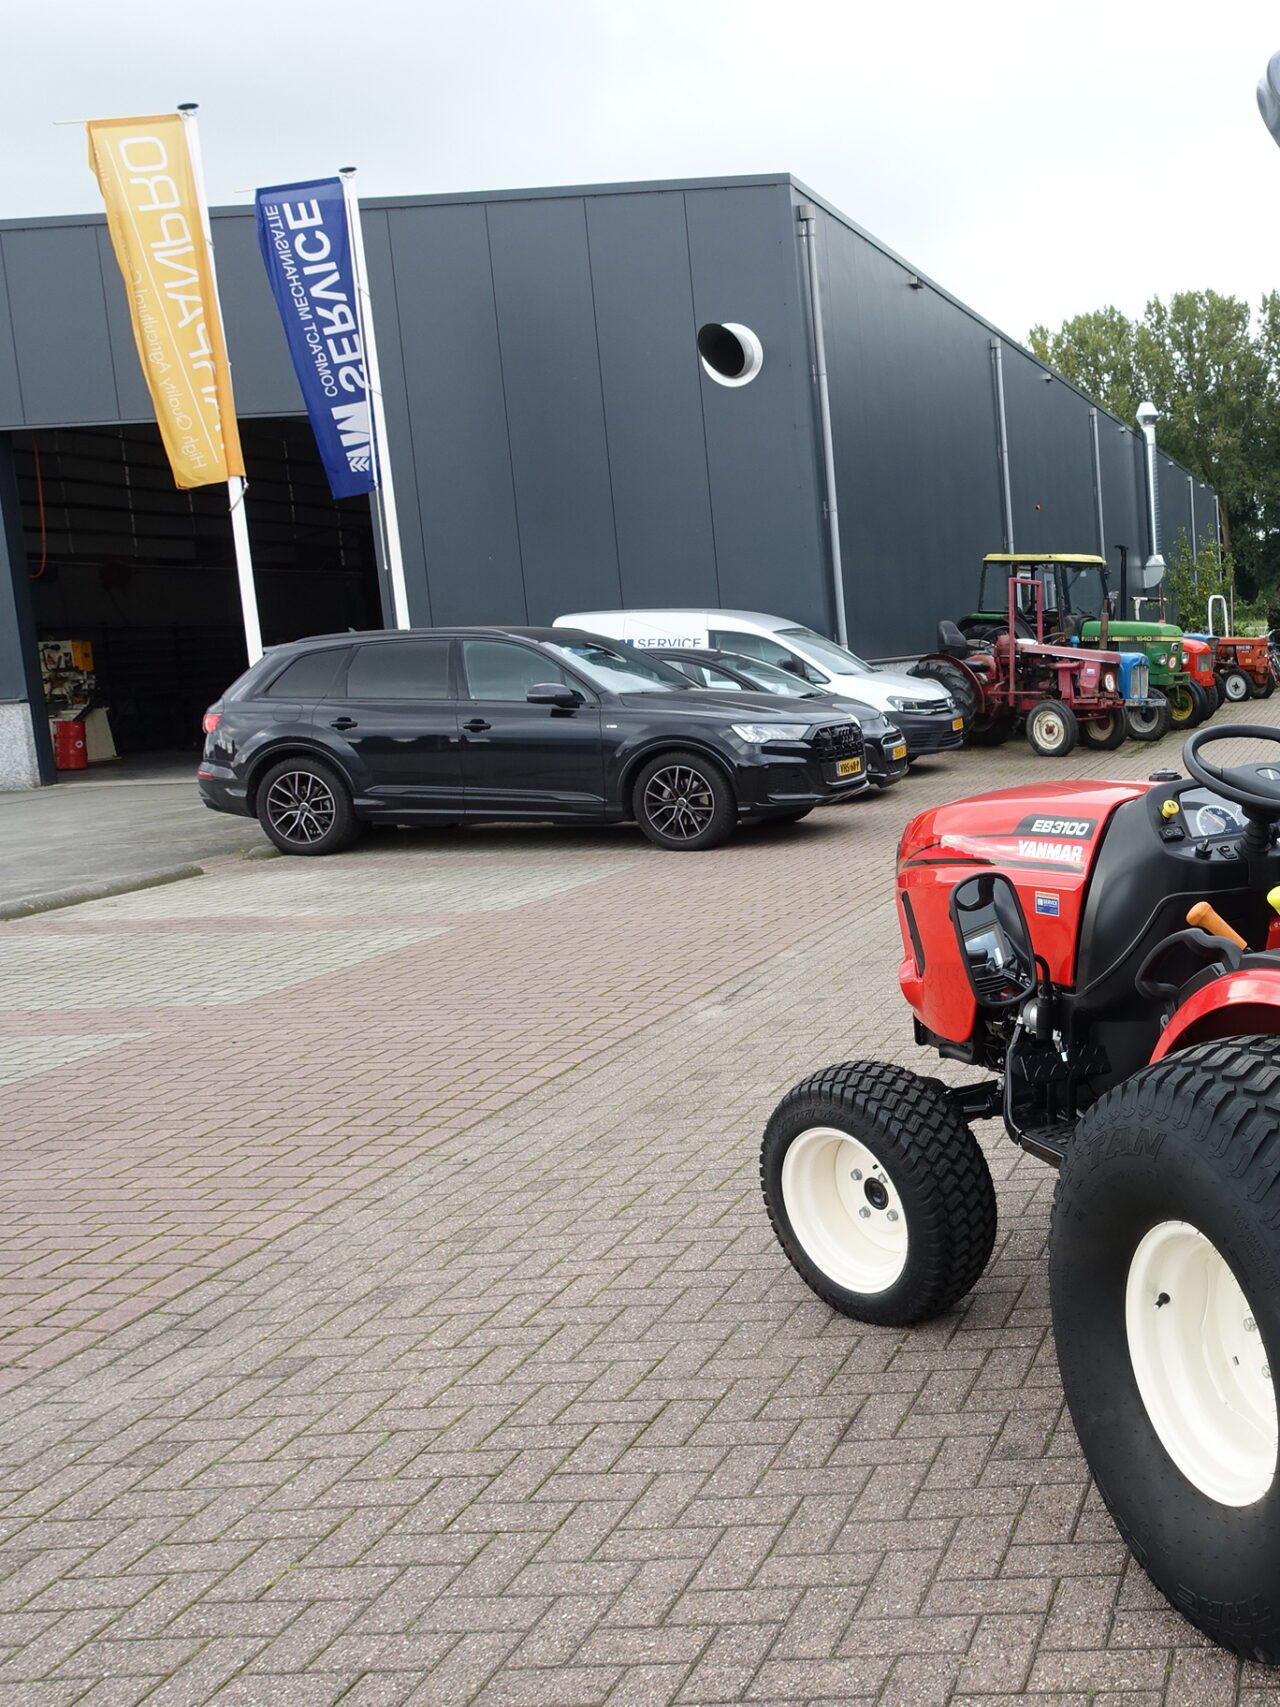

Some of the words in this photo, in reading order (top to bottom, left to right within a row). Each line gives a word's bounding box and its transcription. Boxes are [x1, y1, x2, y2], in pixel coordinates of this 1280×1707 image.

[638, 638, 702, 648] SERVICE
[1031, 819, 1090, 836] EB3100
[1018, 840, 1083, 863] YANMAR
